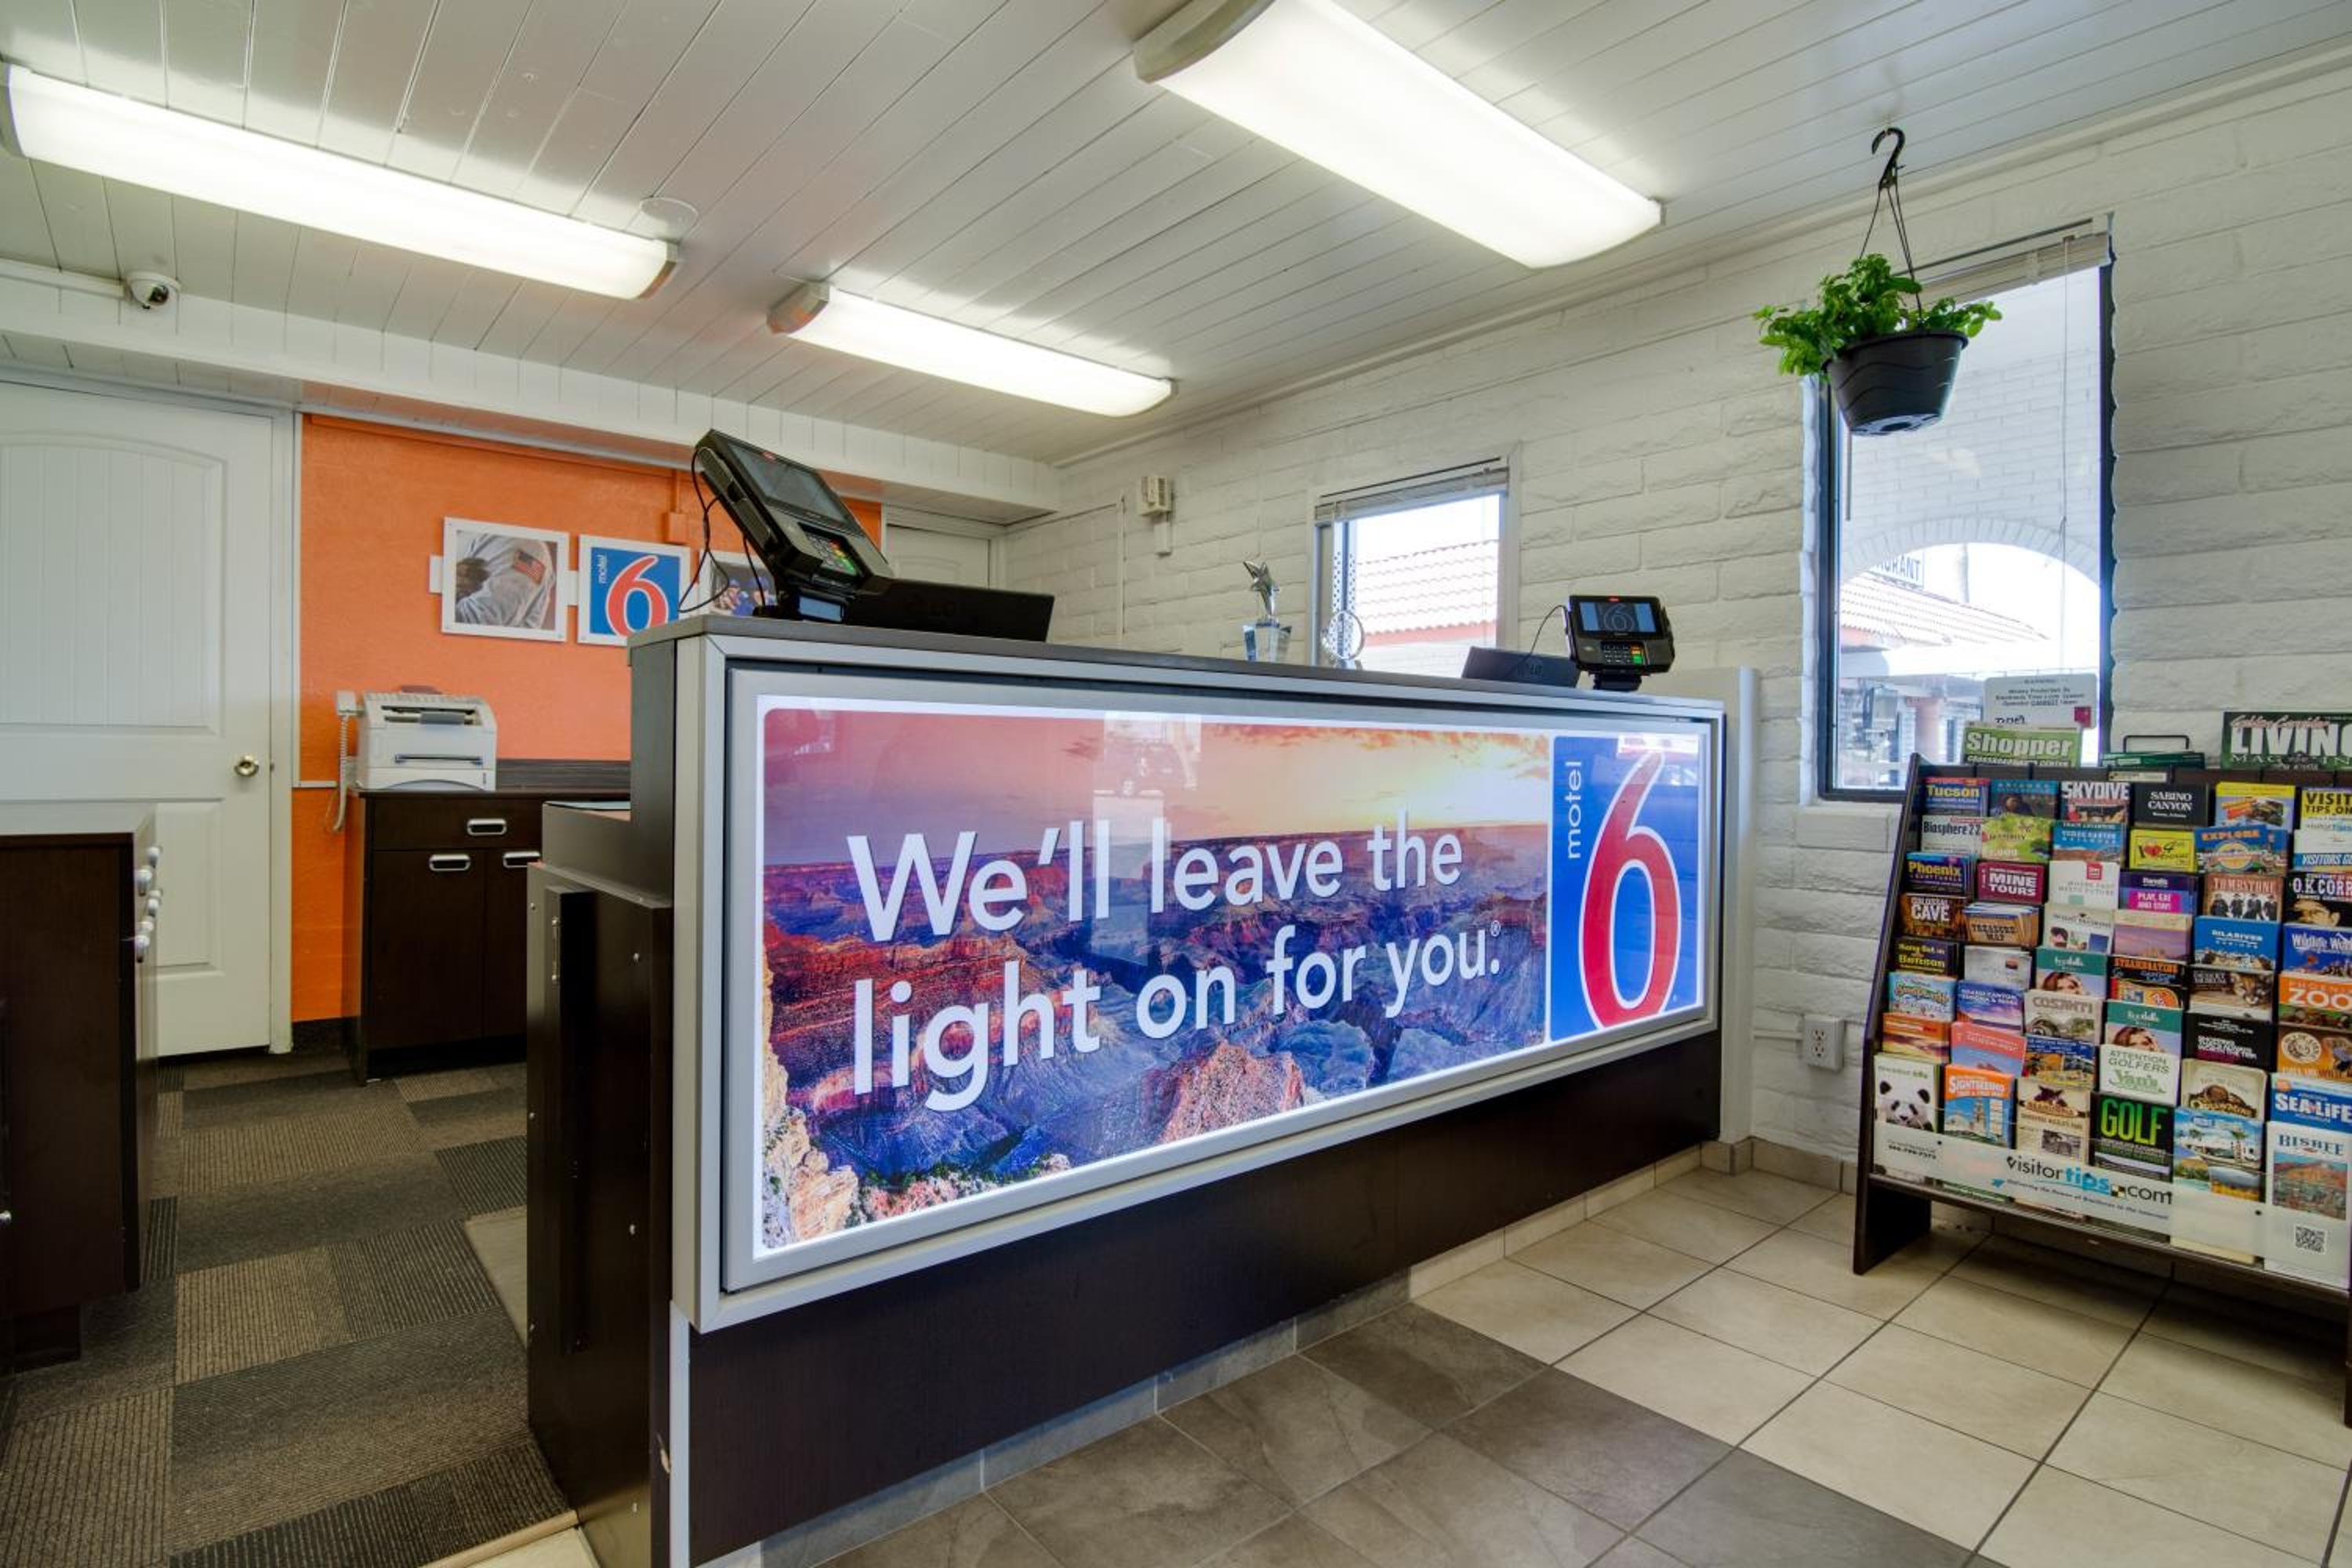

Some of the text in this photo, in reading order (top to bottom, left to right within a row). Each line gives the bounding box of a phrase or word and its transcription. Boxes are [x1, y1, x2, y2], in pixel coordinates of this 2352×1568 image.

[598, 554, 608, 585] motel
[604, 554, 670, 637] 6
[1965, 731, 2074, 757] Shopper
[1926, 784, 1980, 797] Tucson
[2060, 781, 2130, 800] SKYDIVE
[2150, 790, 2193, 802] SABINO
[1565, 760, 1582, 860] motel
[2147, 800, 2193, 811] CANYON
[2306, 805, 2331, 815] TIPS
[1923, 821, 1968, 837] Biosphere
[2201, 829, 2259, 841] EXPLORE
[846, 808, 1463, 942] We'll leave the
[1908, 861, 1962, 877] Phoenix
[1988, 884, 2036, 896] TOURS
[1989, 872, 2037, 890] MINE
[2212, 877, 2277, 893] TOMBSTONE
[1578, 750, 1682, 1032] 6
[1911, 904, 1950, 922] CAVE
[2032, 996, 2093, 1014] COSANTI
[2288, 987, 2352, 1013] ZOO
[853, 960, 1102, 1112] light
[1135, 964, 1236, 1040] on
[1266, 924, 1367, 1016] for
[2108, 1058, 2171, 1074] GOLFERS
[2109, 1049, 2168, 1065] ATTENTION
[2275, 1092, 2310, 1114] SEA
[2100, 1098, 2169, 1146] GOLF
[2278, 1134, 2344, 1156] BISBEE
